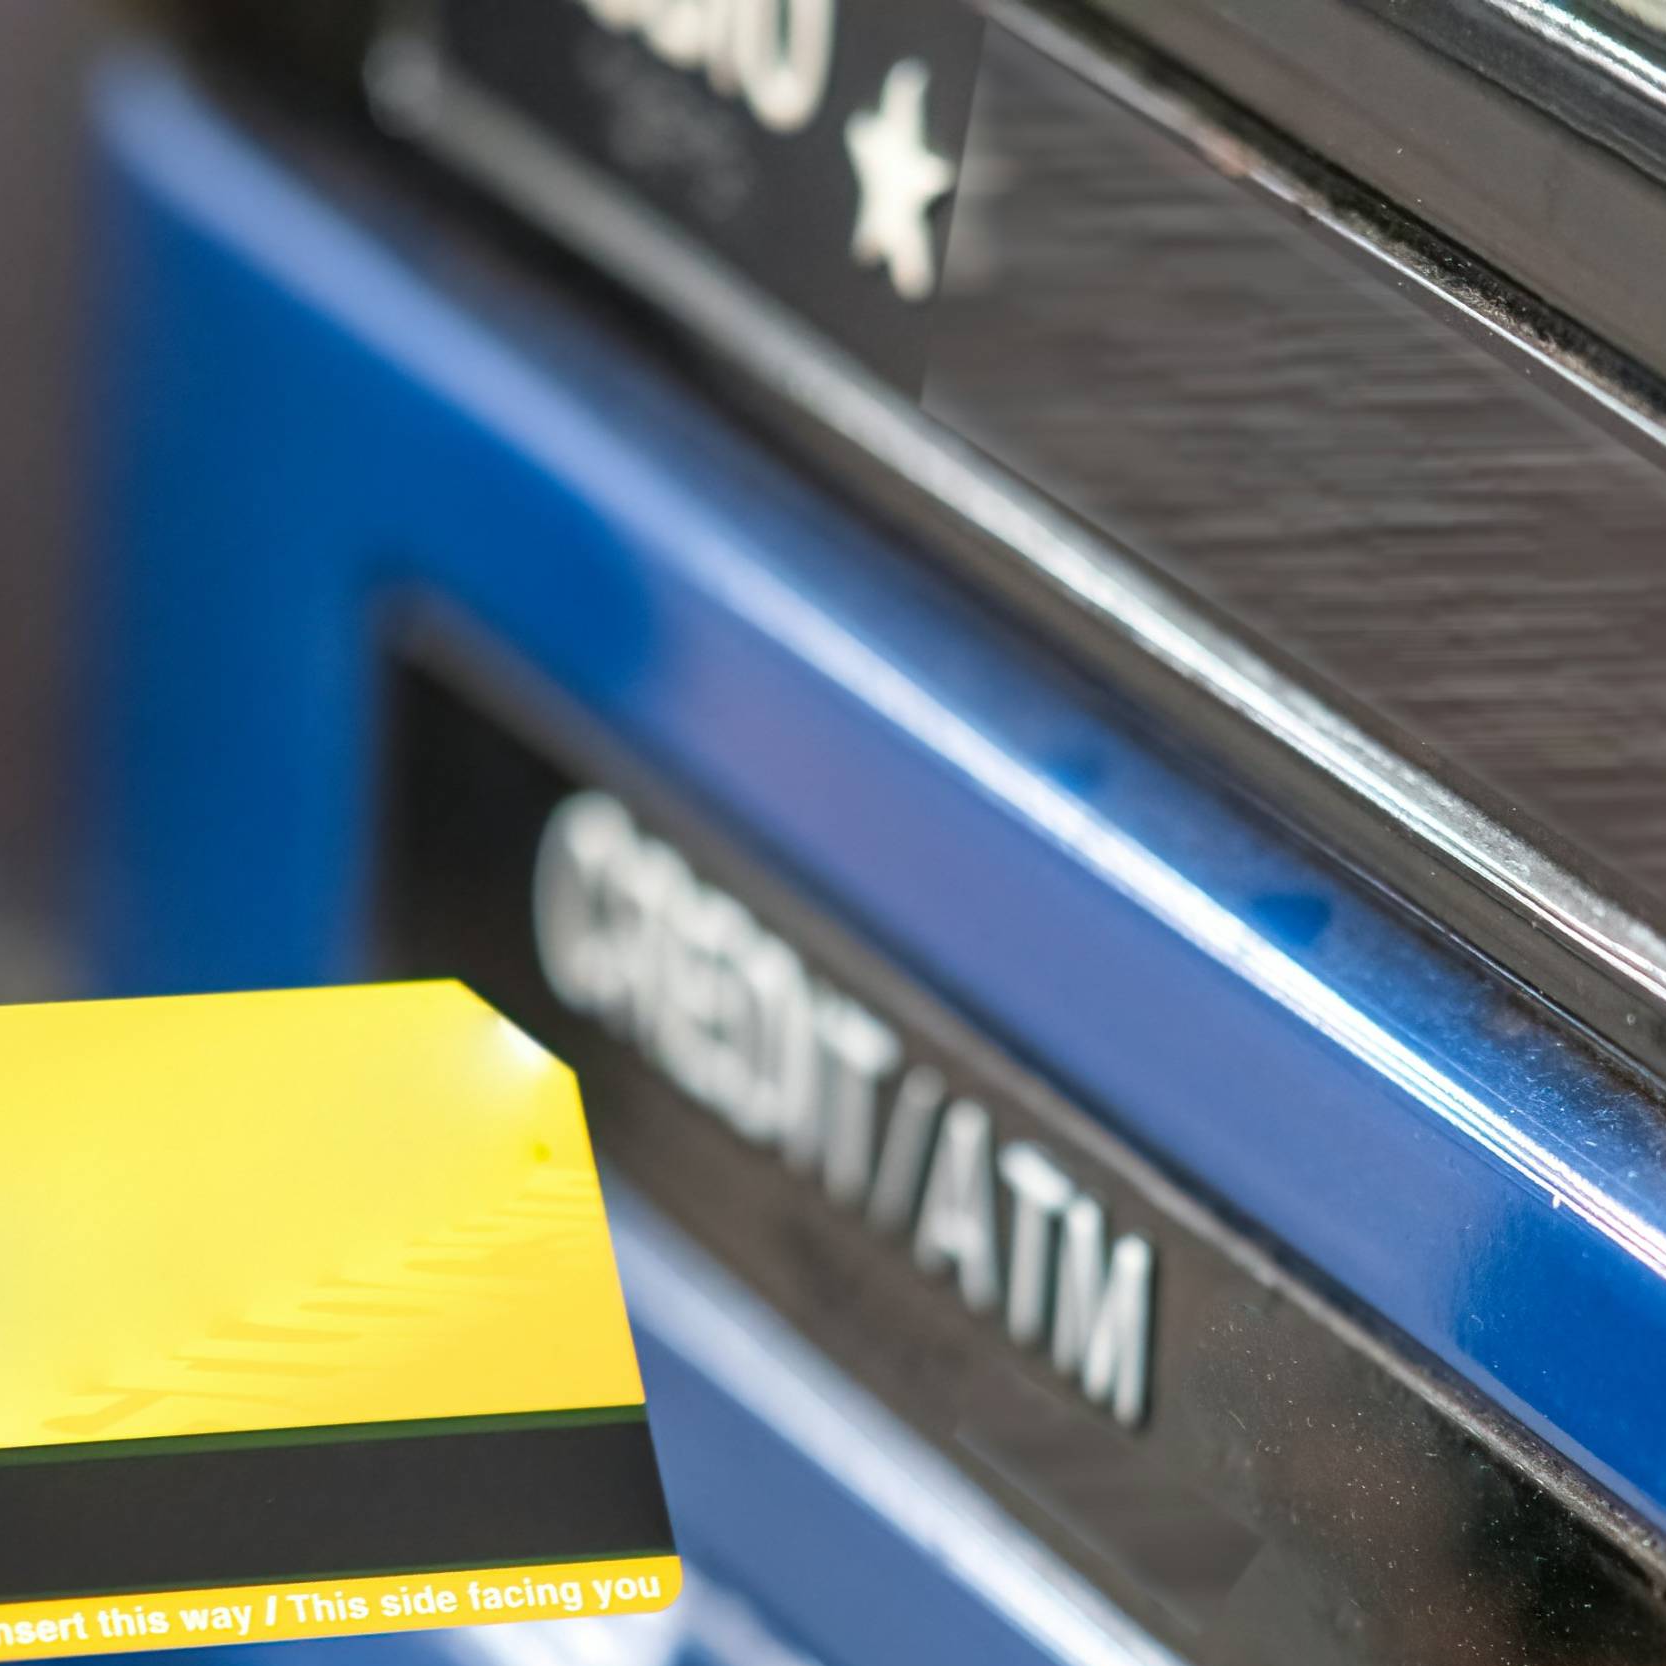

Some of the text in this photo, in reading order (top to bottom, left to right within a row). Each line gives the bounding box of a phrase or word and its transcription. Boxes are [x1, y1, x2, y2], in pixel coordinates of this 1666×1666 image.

[533, 790, 1159, 1430] CREDIT/ATM
[97, 1605, 170, 1637] this
[179, 1604, 252, 1636] way
[264, 1594, 278, 1626] /
[285, 1590, 369, 1623] This
[380, 1585, 458, 1617] side
[467, 1576, 584, 1612] facing
[591, 1575, 661, 1609] you
